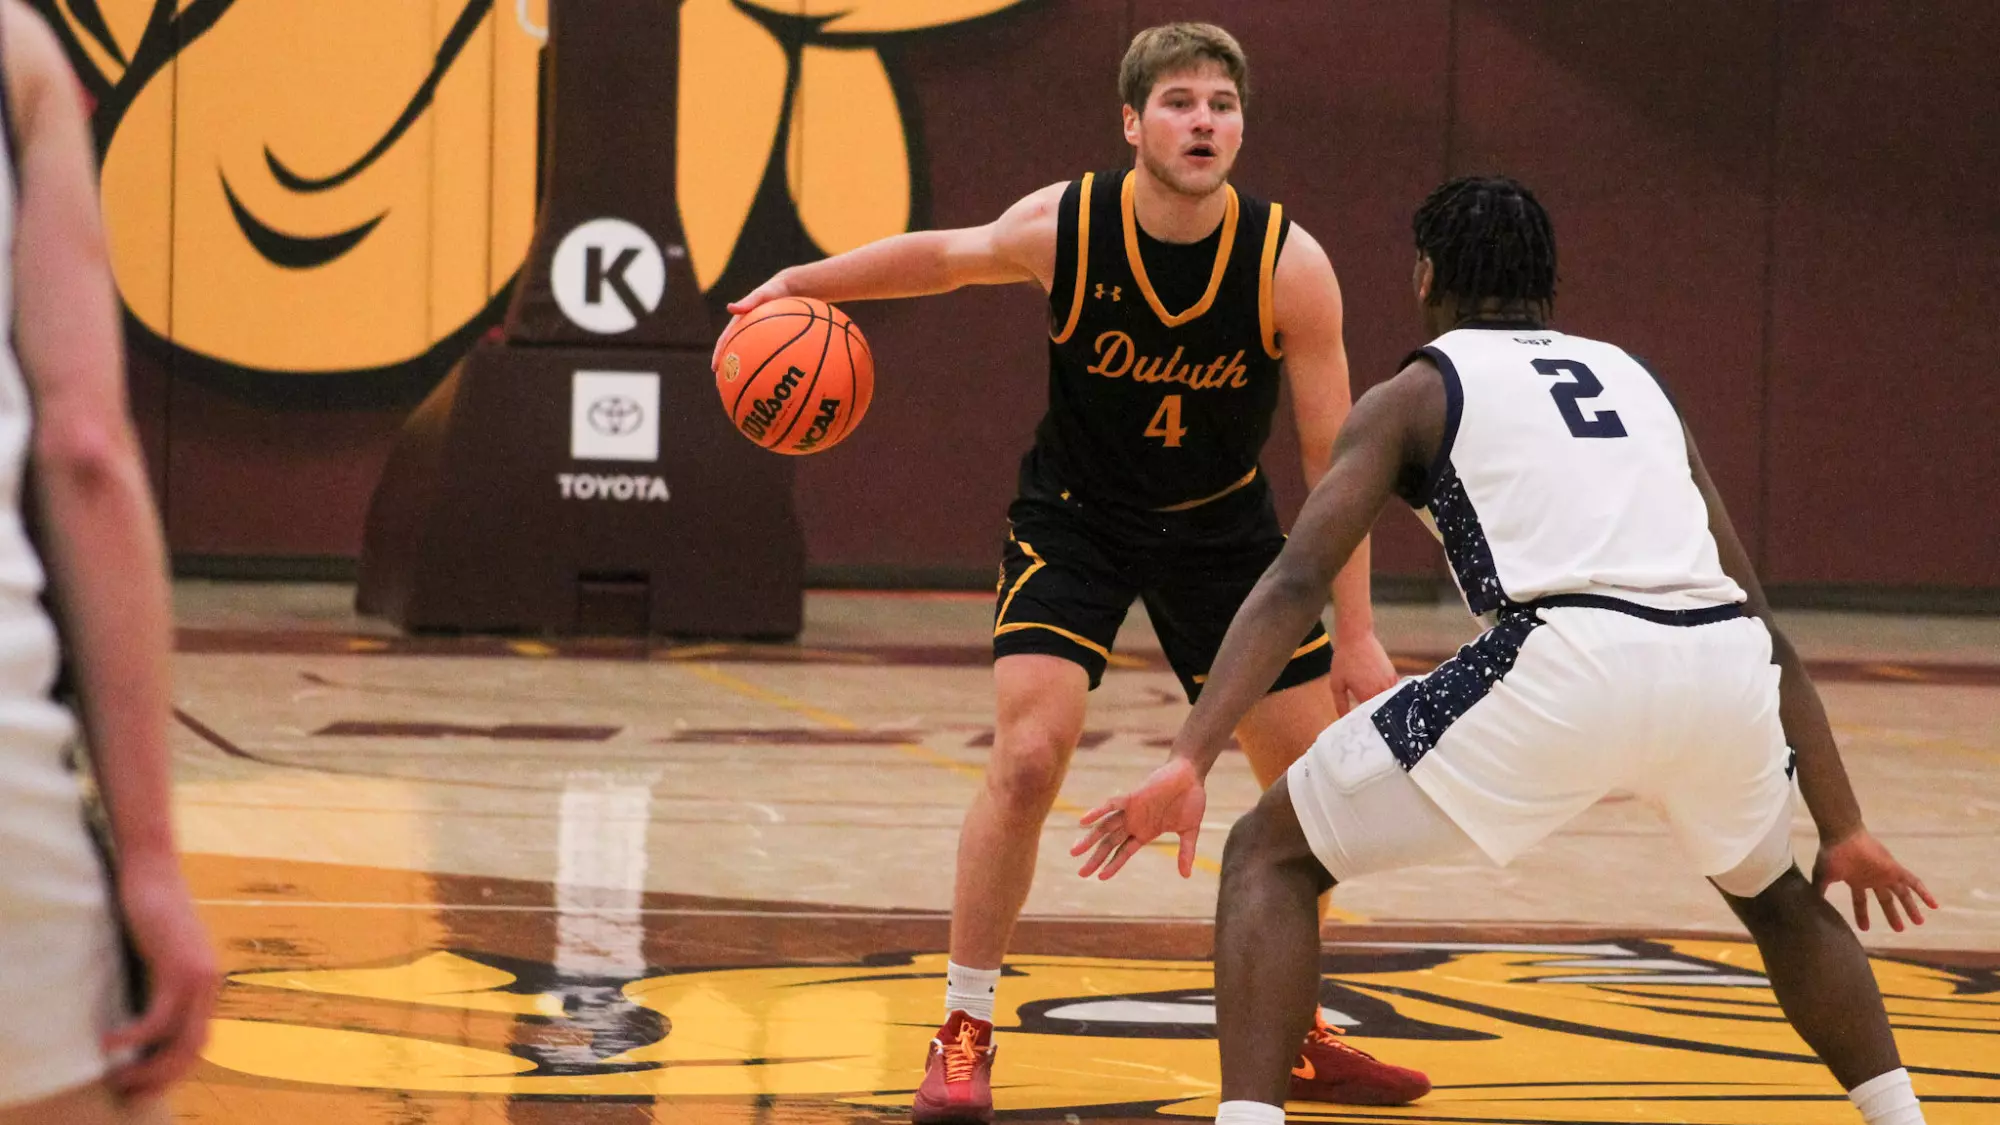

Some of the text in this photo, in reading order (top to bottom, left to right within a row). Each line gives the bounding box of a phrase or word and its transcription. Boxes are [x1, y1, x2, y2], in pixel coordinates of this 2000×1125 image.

[1087, 330, 1248, 390] Duluth
[741, 365, 806, 441] Wilson
[791, 398, 841, 451] NCAA
[1143, 394, 1188, 447] 4
[1529, 358, 1628, 439] 2
[557, 473, 670, 501] TOYOTA
